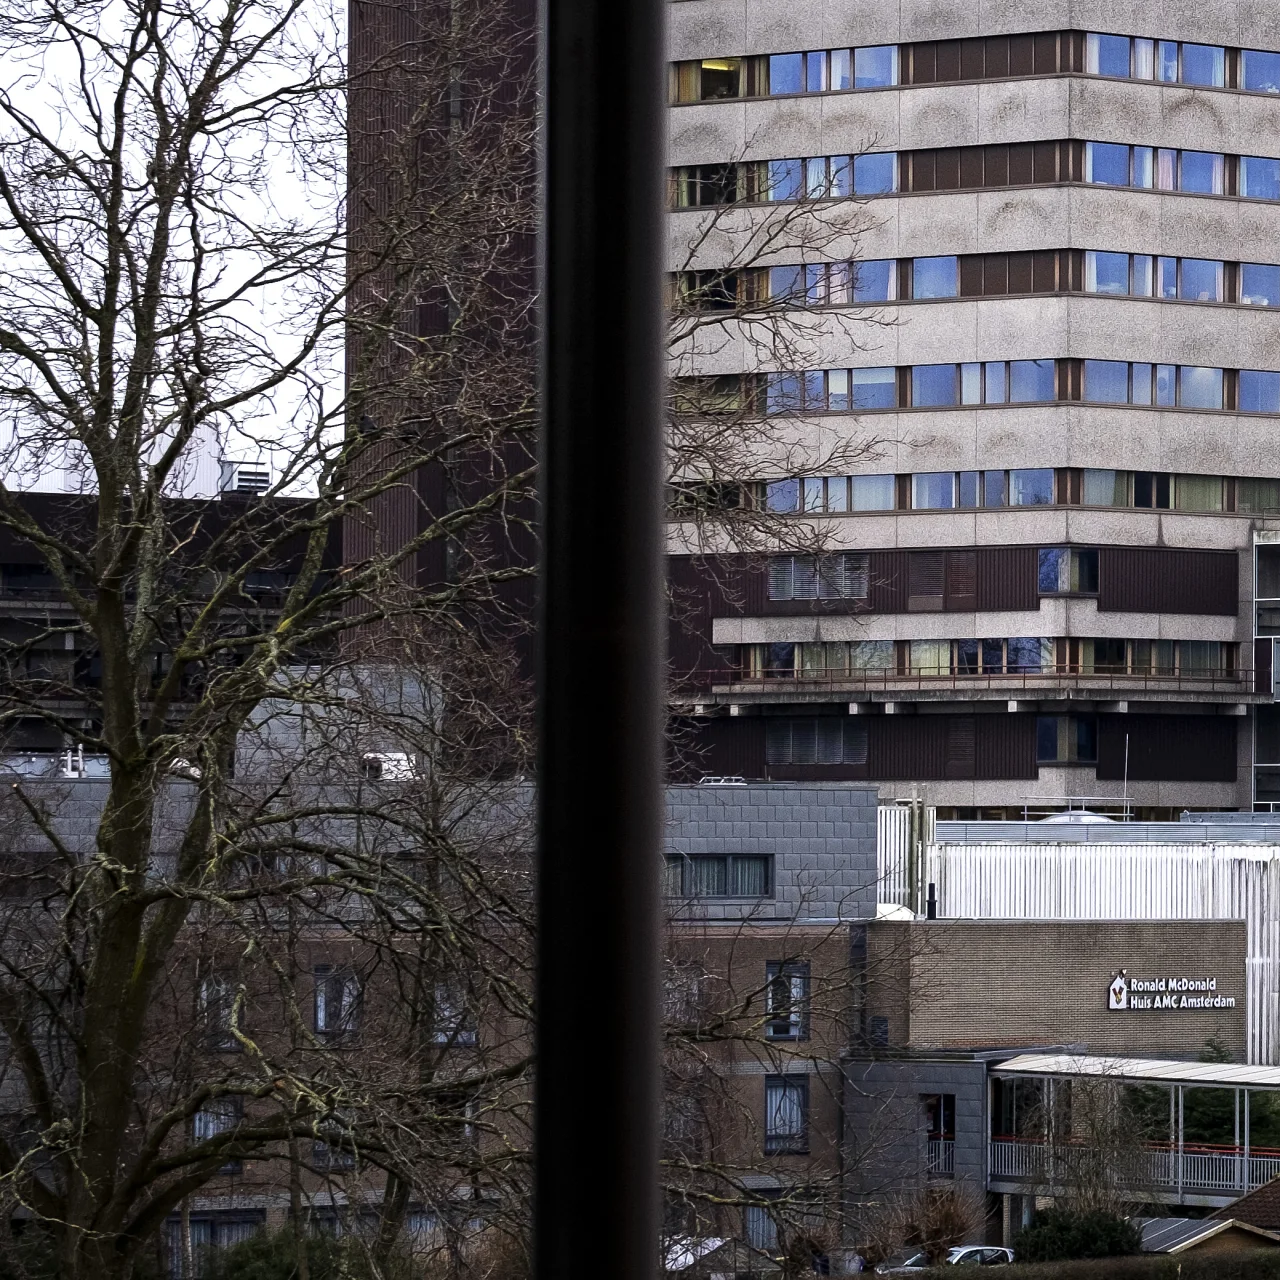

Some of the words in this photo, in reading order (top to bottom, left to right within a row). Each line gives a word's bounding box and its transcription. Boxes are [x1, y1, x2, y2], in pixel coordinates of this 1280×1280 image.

[1130, 978, 1166, 992] Ronald
[1168, 977, 1217, 992] McDonald
[1130, 995, 1152, 1009] Huis
[1153, 995, 1179, 1009] AMC
[1180, 994, 1236, 1009] Amsterdam
